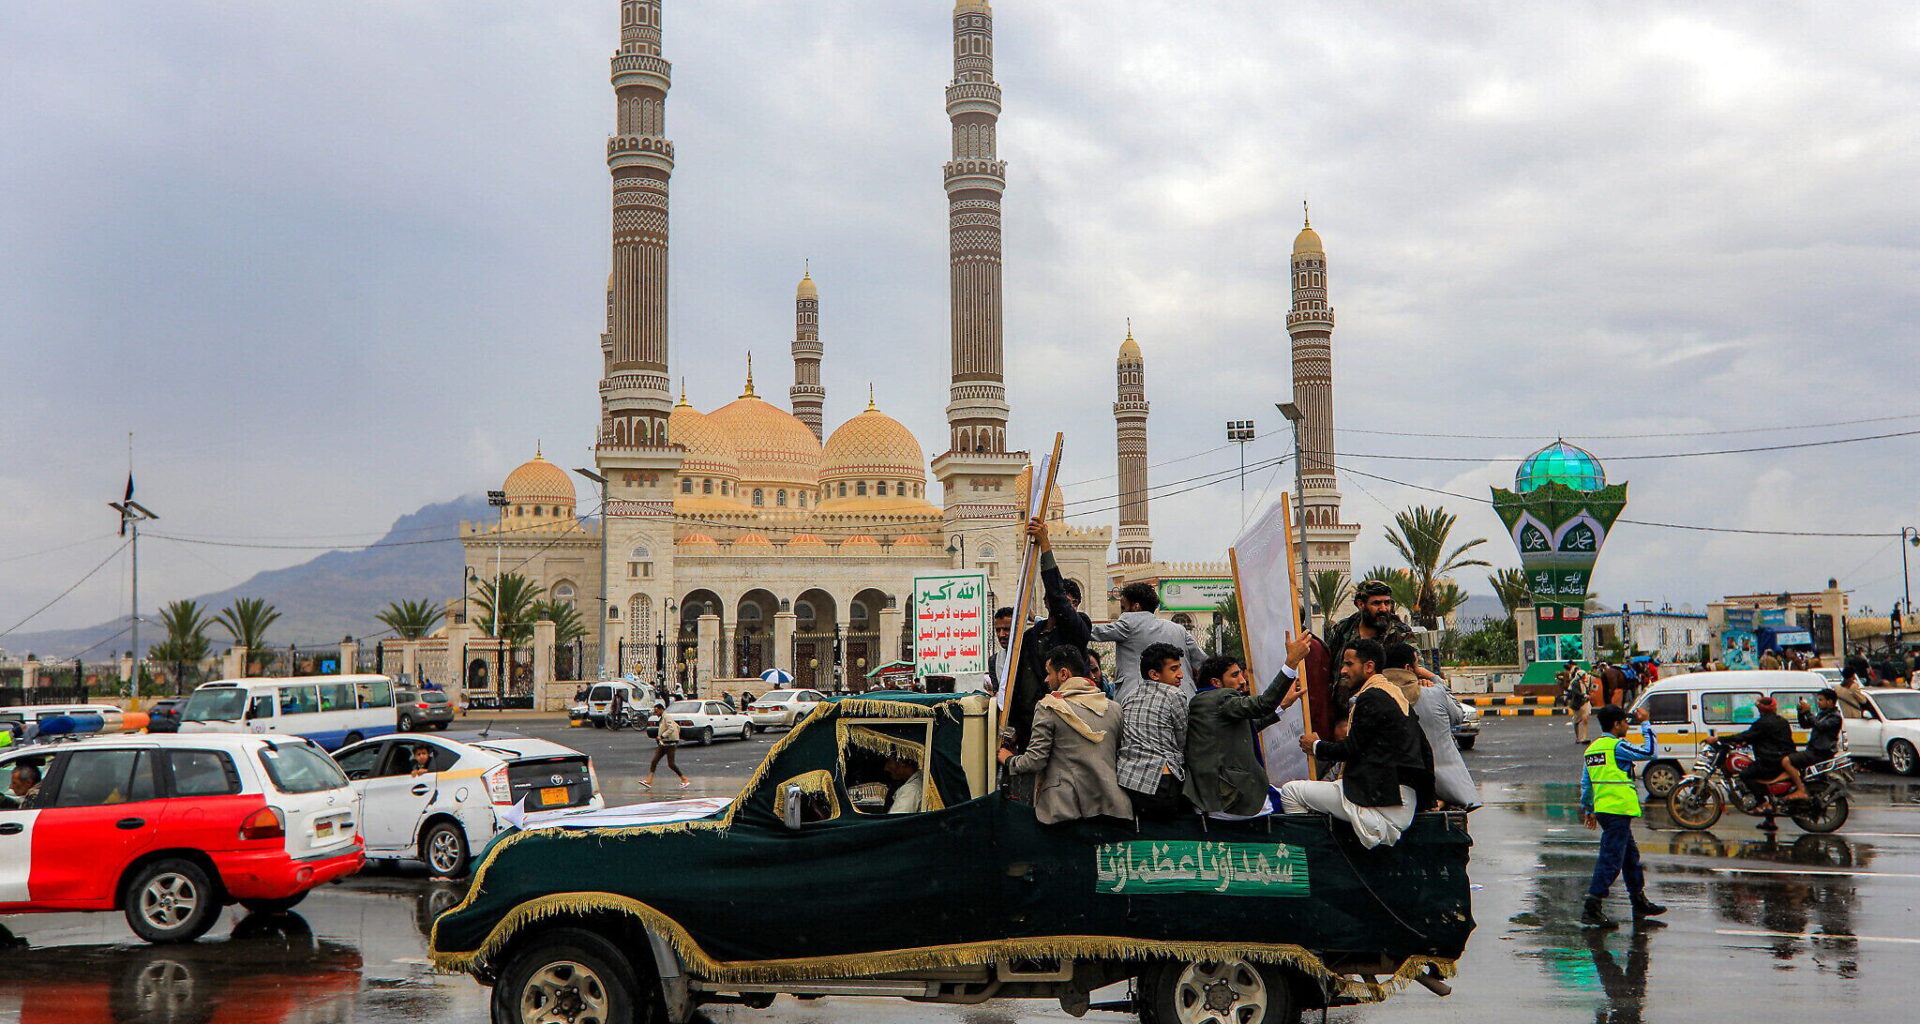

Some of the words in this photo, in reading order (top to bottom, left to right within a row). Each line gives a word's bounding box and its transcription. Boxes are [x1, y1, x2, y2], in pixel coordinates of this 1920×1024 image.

[1526, 531, 1544, 549] محمد
[1567, 531, 1593, 549] محمد
[918, 580, 956, 606] أكبر
[957, 581, 980, 599] الله
[953, 606, 980, 621] الموت
[953, 626, 980, 640] الموت
[918, 645, 941, 660] اليهود
[944, 645, 957, 659] على
[960, 644, 981, 656] اللعنة
[1096, 842, 1197, 892] عظماؤنا
[1197, 841, 1293, 892] شهداؤنا
